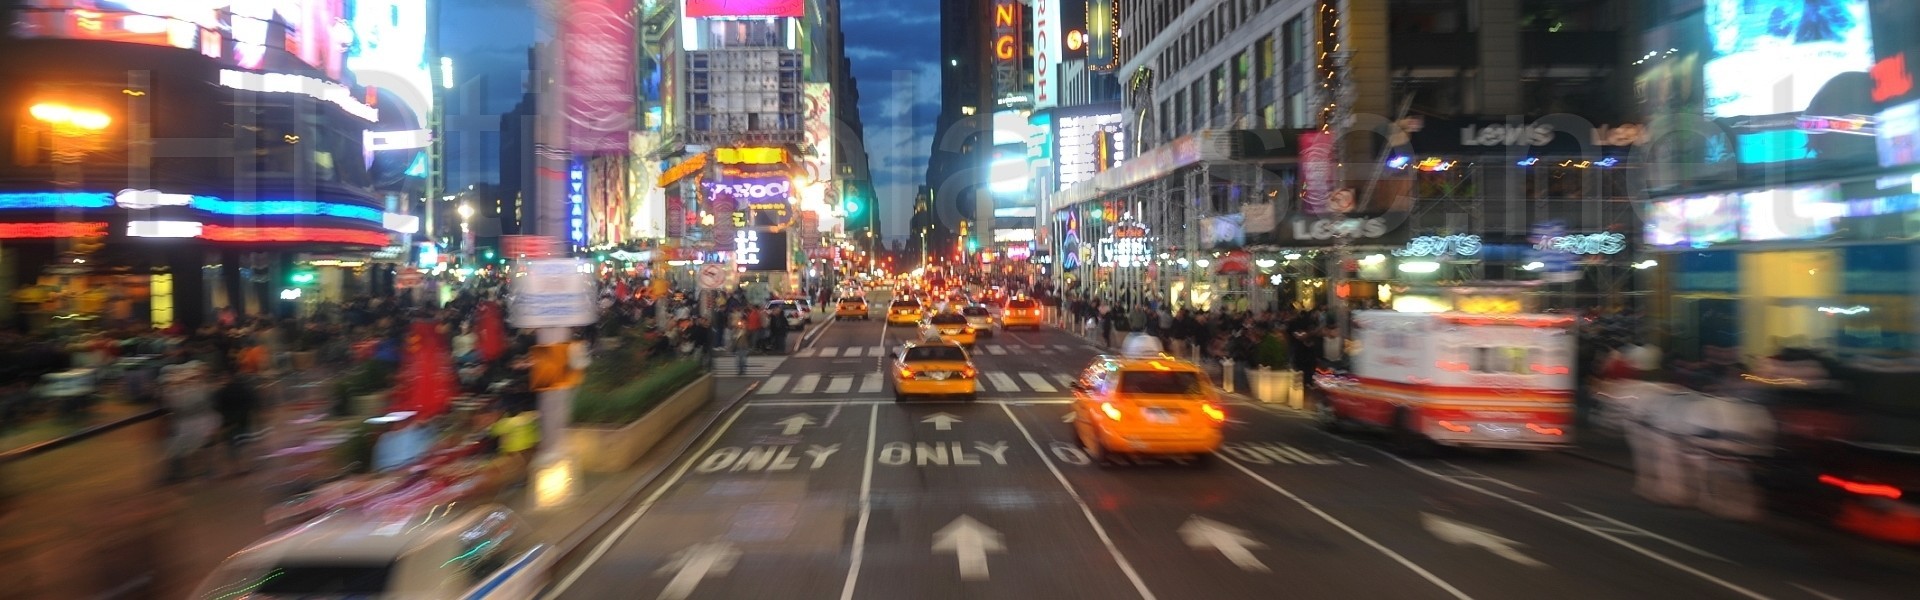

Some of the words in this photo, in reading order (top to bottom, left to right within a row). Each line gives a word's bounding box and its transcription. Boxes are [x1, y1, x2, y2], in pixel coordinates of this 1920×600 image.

[1037, 0, 1047, 102] RICOH
[696, 442, 842, 474] ONLY
[878, 440, 1010, 466] ONLY
[1222, 441, 1370, 467] ONL
